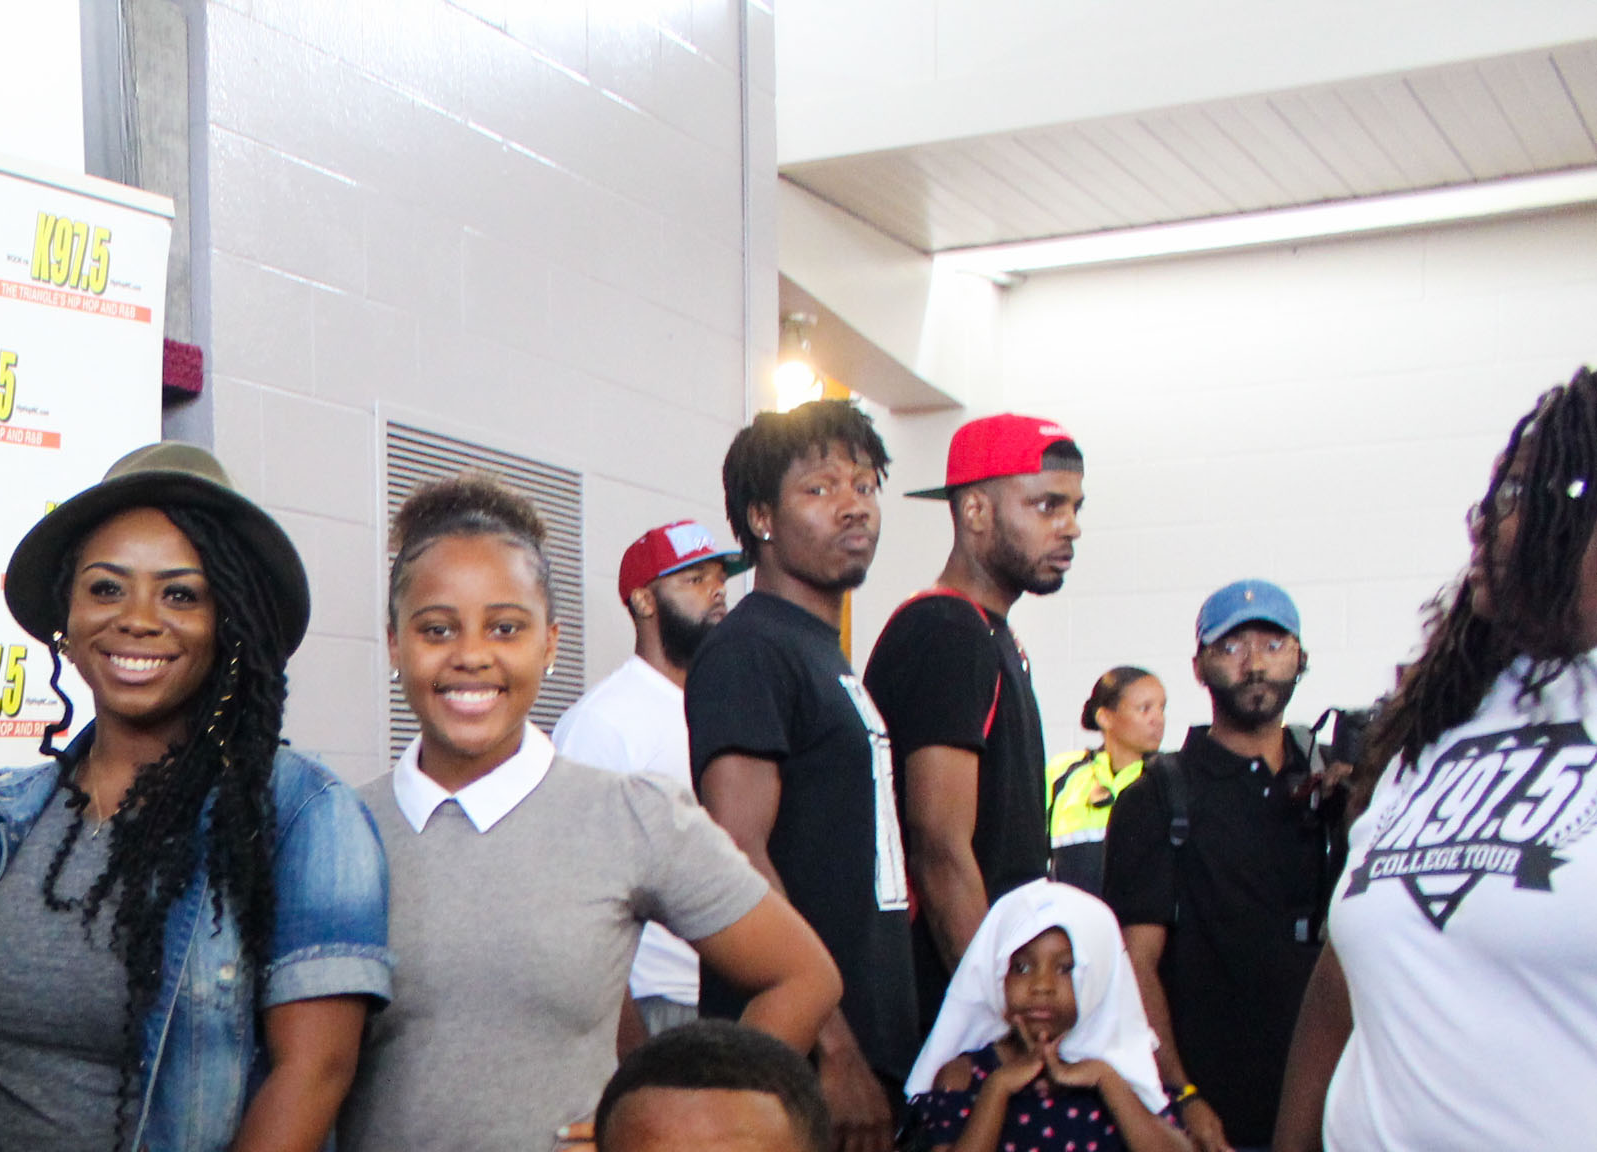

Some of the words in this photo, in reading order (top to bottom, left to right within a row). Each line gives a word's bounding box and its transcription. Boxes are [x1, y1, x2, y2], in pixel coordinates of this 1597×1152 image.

[31, 211, 111, 295] K97.5
[6, 430, 23, 442] AND
[25, 432, 43, 444] R&B
[15, 723, 33, 736] AND
[1373, 744, 1597, 850] K97.5
[1371, 850, 1460, 875] COLLEGE
[1463, 846, 1520, 872] TOUR
